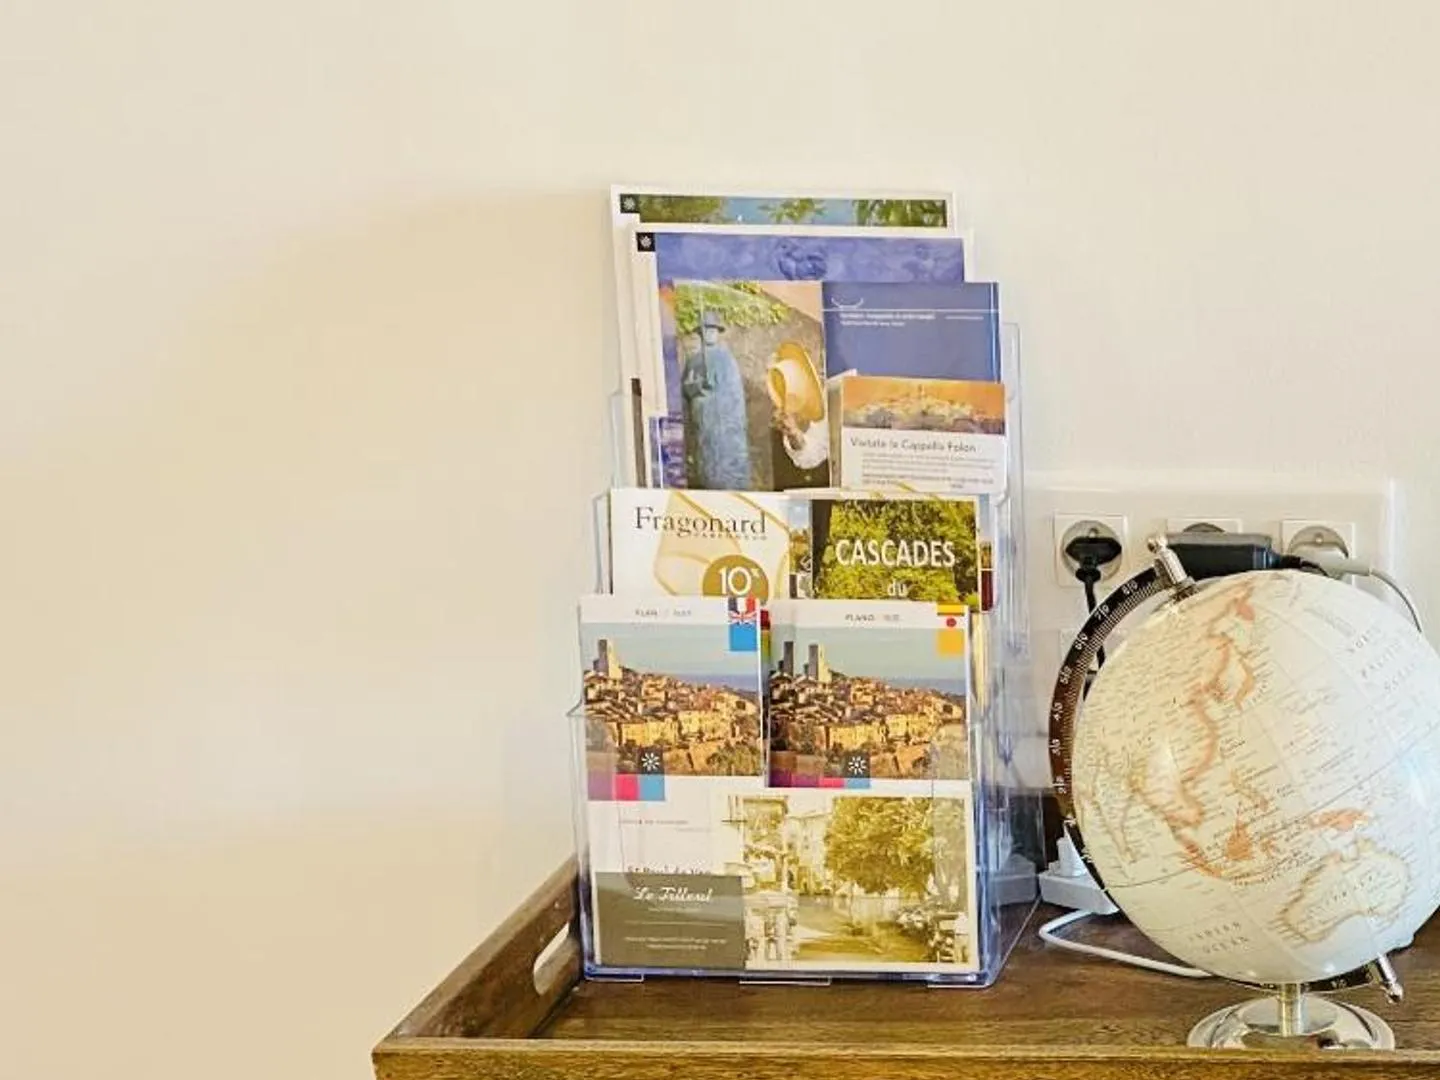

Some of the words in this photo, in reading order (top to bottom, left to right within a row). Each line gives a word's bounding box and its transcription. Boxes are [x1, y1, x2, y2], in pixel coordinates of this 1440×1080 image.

[635, 506, 767, 538] Fragonard
[835, 539, 955, 567] CASCADES
[887, 579, 908, 597] du
